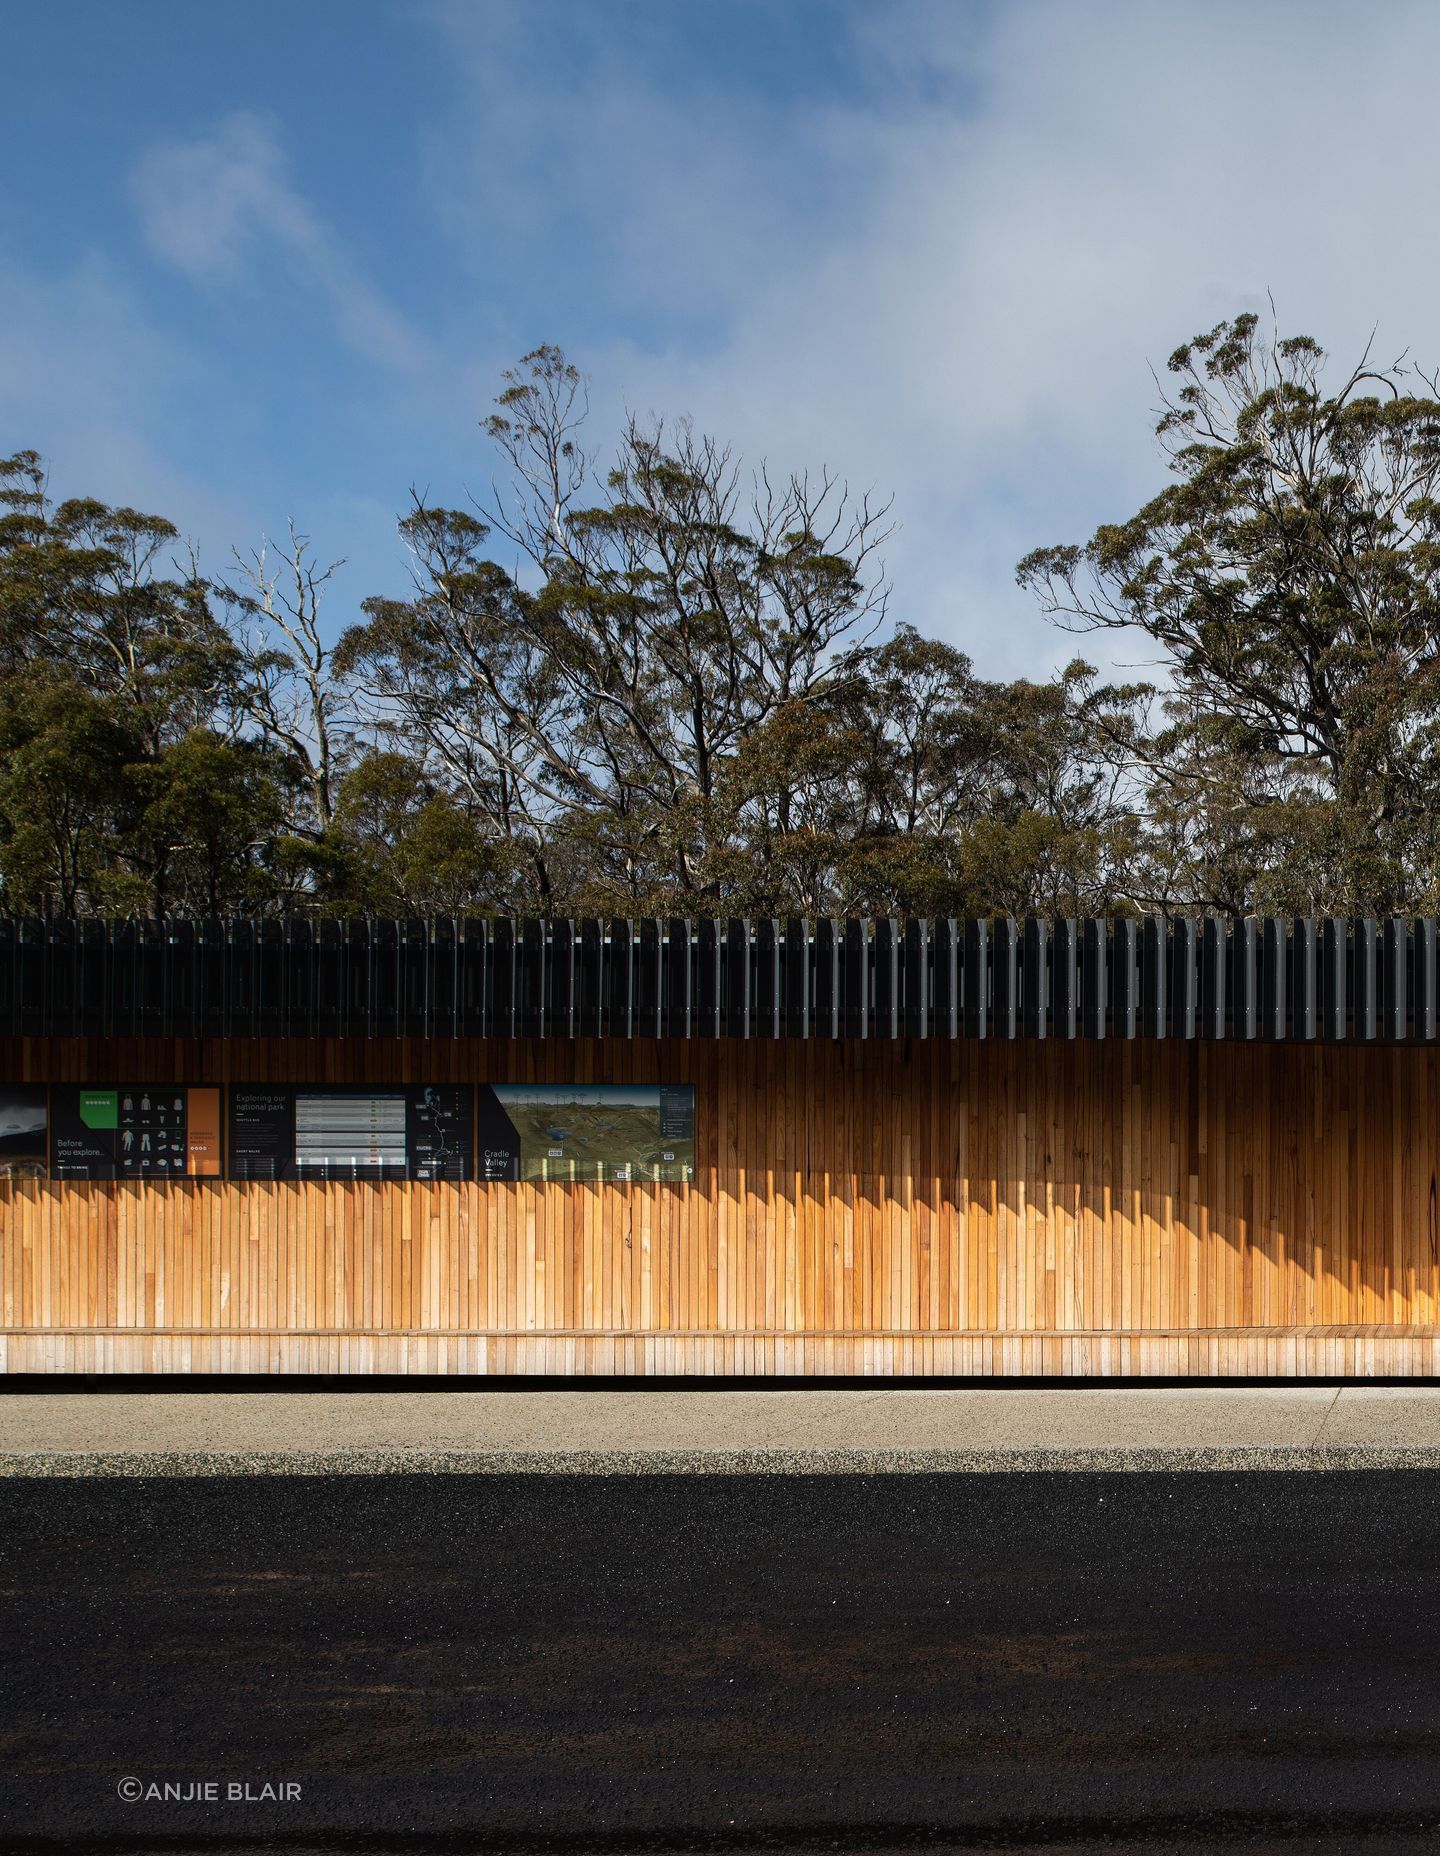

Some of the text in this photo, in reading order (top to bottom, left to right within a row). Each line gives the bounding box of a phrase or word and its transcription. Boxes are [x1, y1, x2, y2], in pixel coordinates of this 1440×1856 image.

[236, 1094, 272, 1104] Exploring
[236, 1103, 285, 1112] national park
[57, 1139, 83, 1148] Before
[57, 1150, 72, 1158] you
[484, 1149, 510, 1158] Cradle
[484, 1158, 508, 1168] Valley
